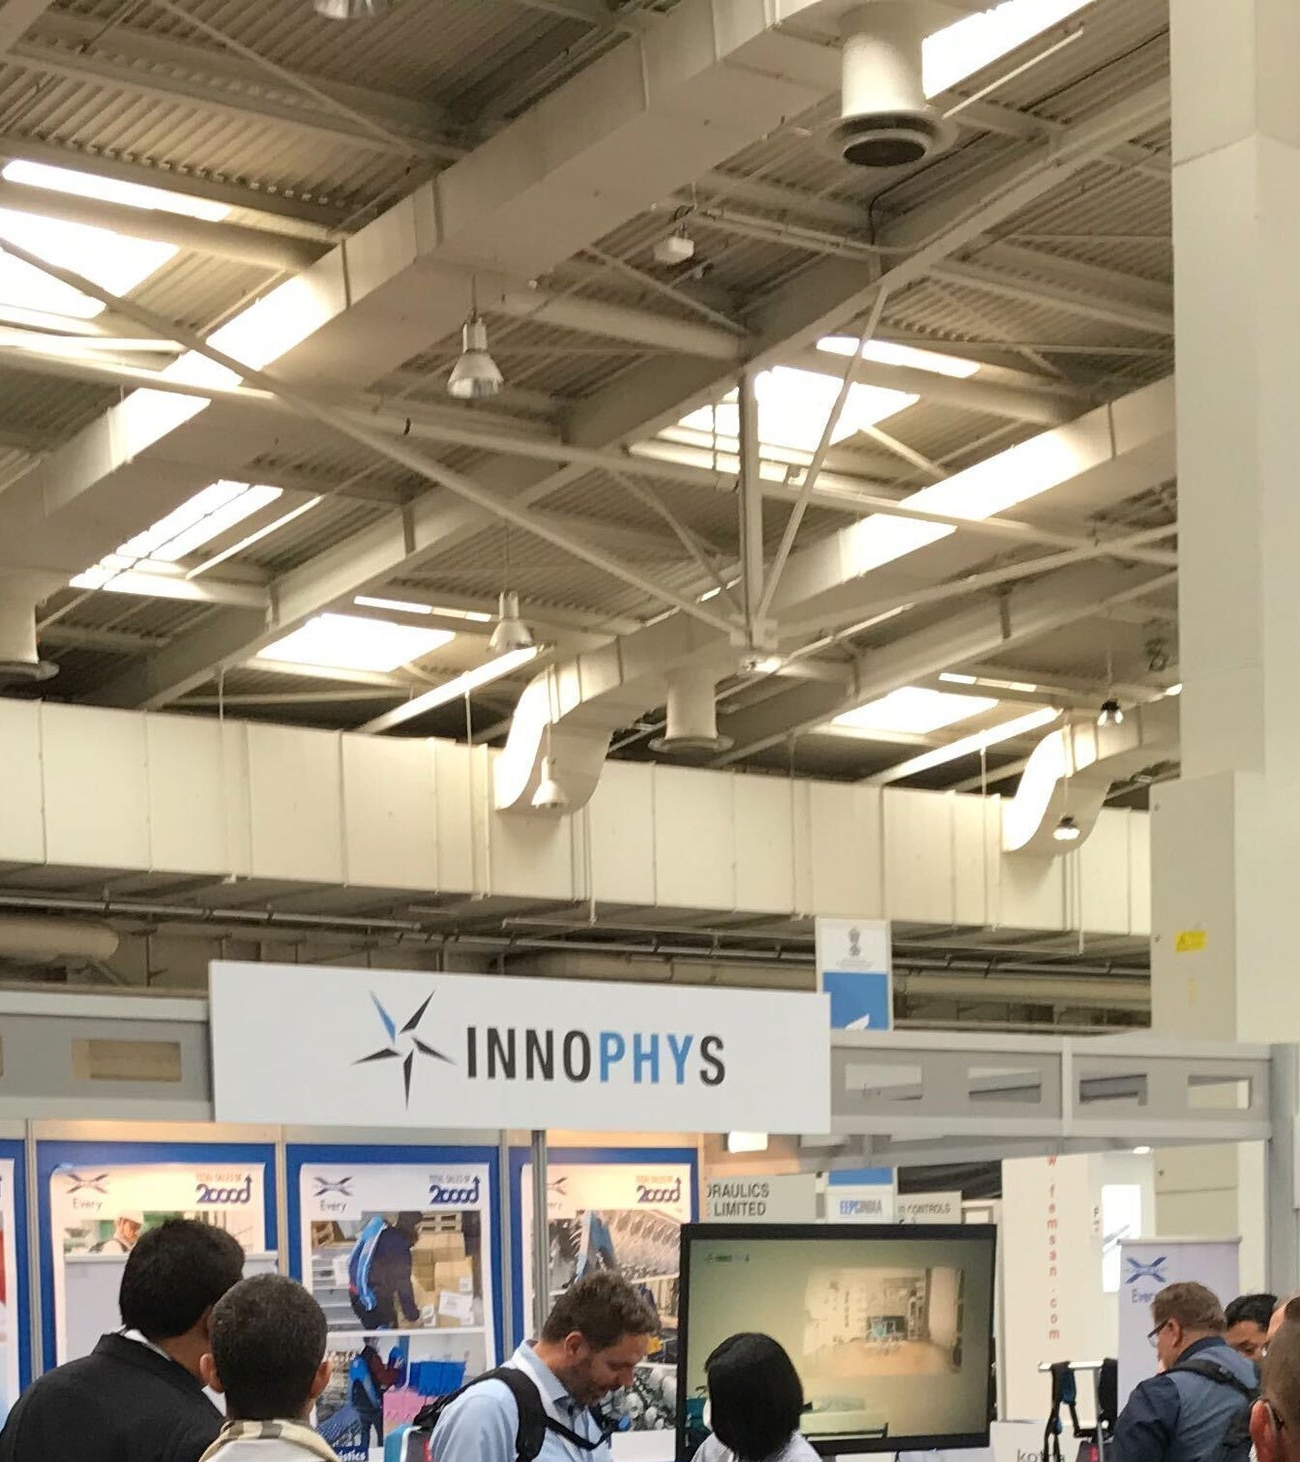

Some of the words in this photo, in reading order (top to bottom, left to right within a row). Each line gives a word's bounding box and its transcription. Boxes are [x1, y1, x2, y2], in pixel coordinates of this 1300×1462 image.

[467, 1026, 725, 1087] INNOPHYS
[714, 1201, 767, 1217] LIMITED
[339, 1449, 366, 1461] istics
